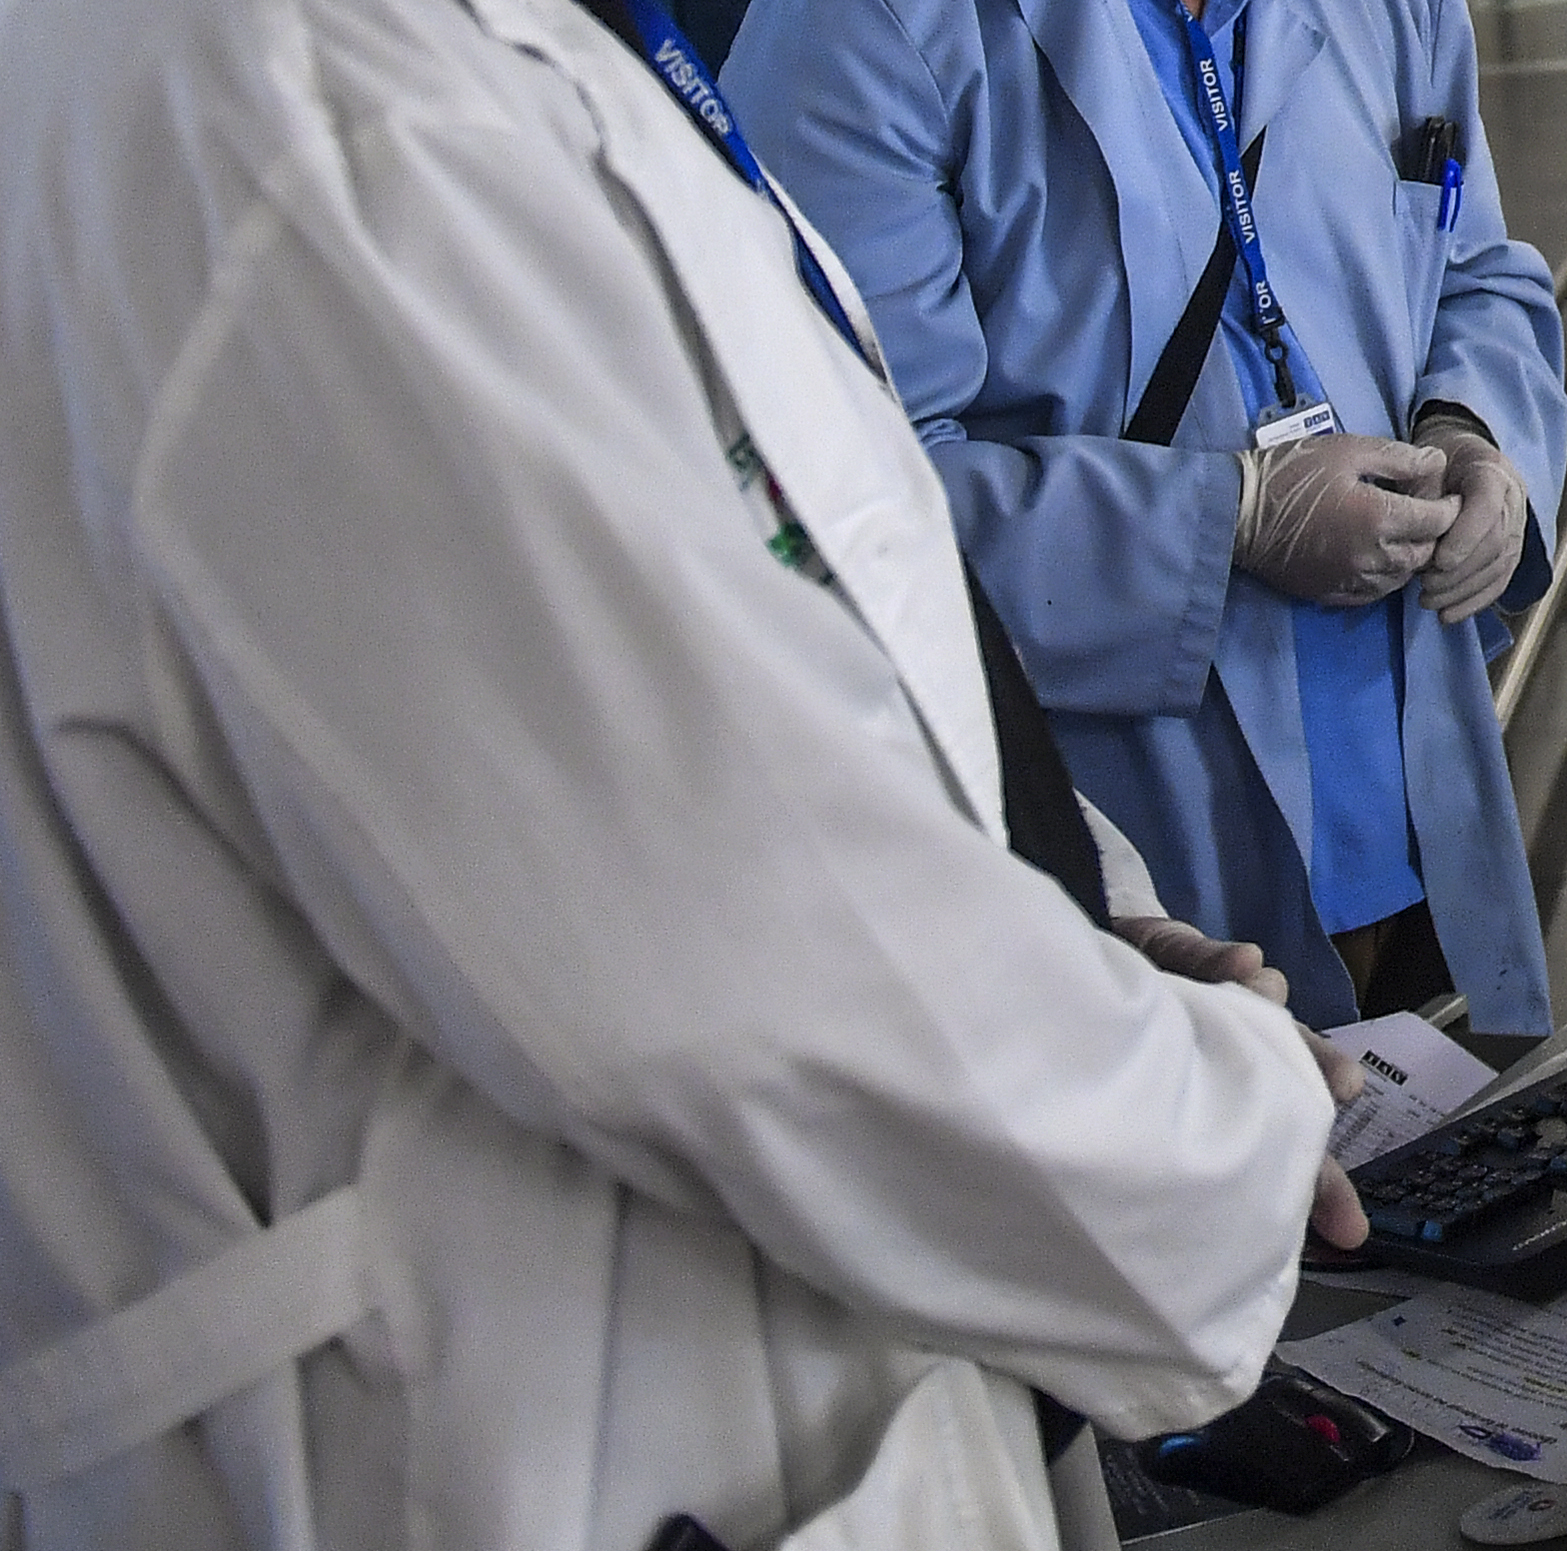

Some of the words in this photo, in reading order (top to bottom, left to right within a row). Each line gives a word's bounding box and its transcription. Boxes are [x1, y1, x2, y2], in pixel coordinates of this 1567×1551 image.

[655, 38, 731, 136] VISITOR
[1199, 57, 1228, 133] VISITOR
[1228, 169, 1256, 245] VISITOR
